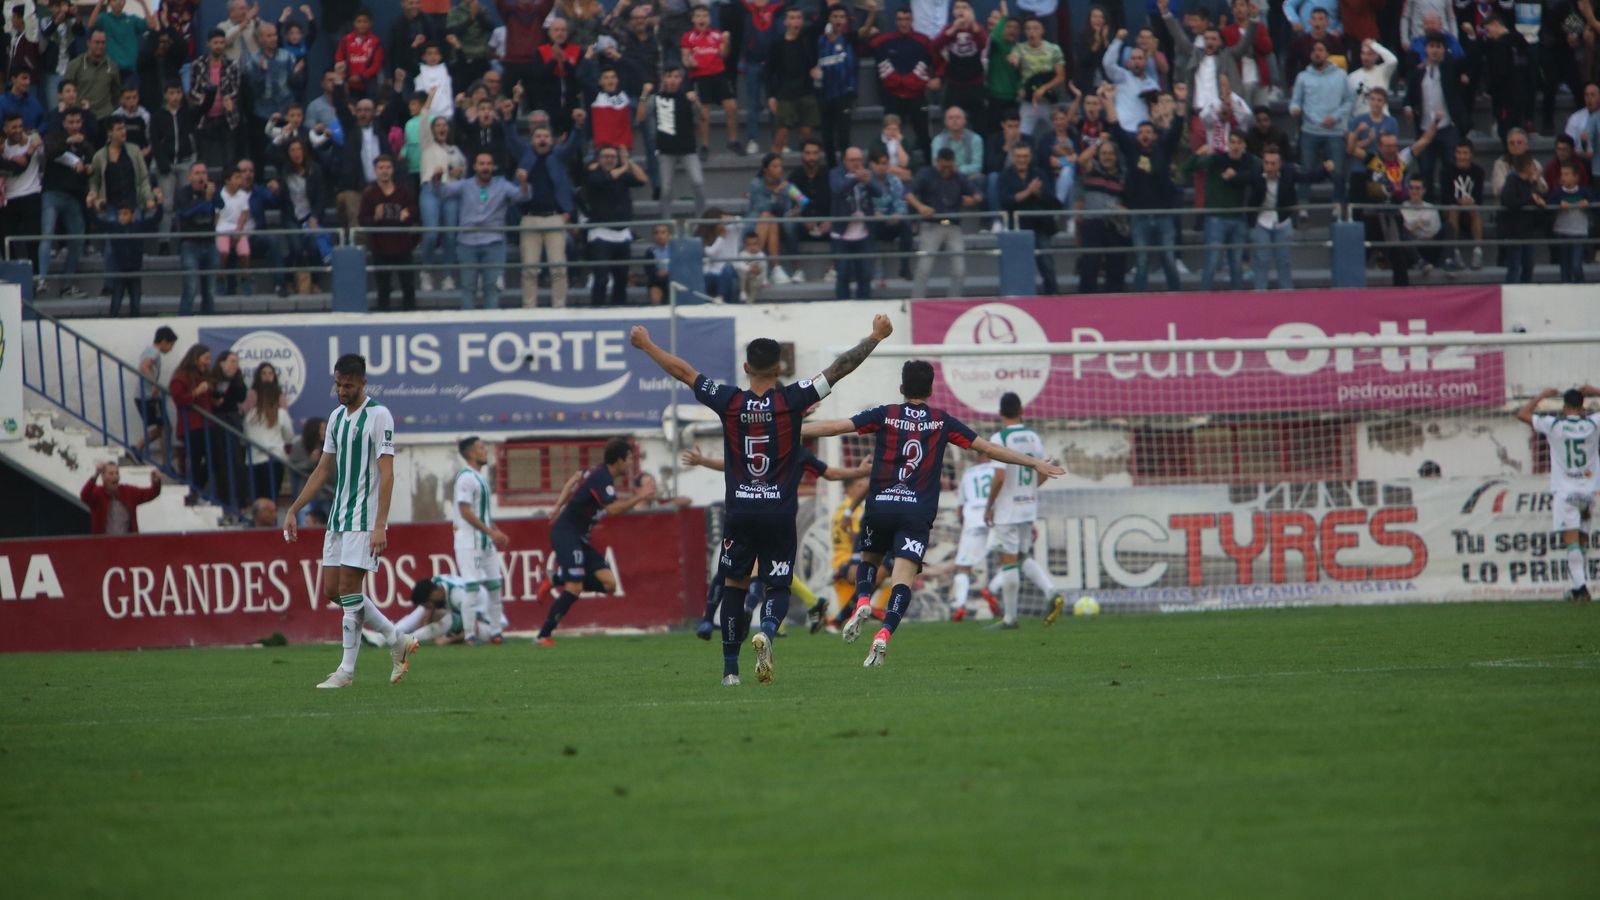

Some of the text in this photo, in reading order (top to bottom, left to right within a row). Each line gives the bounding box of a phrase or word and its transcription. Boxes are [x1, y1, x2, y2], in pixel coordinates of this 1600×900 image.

[236, 349, 292, 361] CALIDAD
[329, 334, 441, 376] LUIS
[459, 330, 627, 373] FORTE
[1071, 319, 1476, 380] Pedro Ortiz
[994, 367, 1041, 380] Ortiz
[904, 406, 927, 418] top
[744, 435, 771, 477] 5
[898, 439, 923, 481] 3
[1564, 439, 1587, 469] 15
[973, 474, 993, 498] 12
[1451, 528, 1485, 553] Tu
[102, 559, 291, 619] GRANDES
[300, 554, 417, 611] VOS
[1461, 562, 1498, 583] LO
